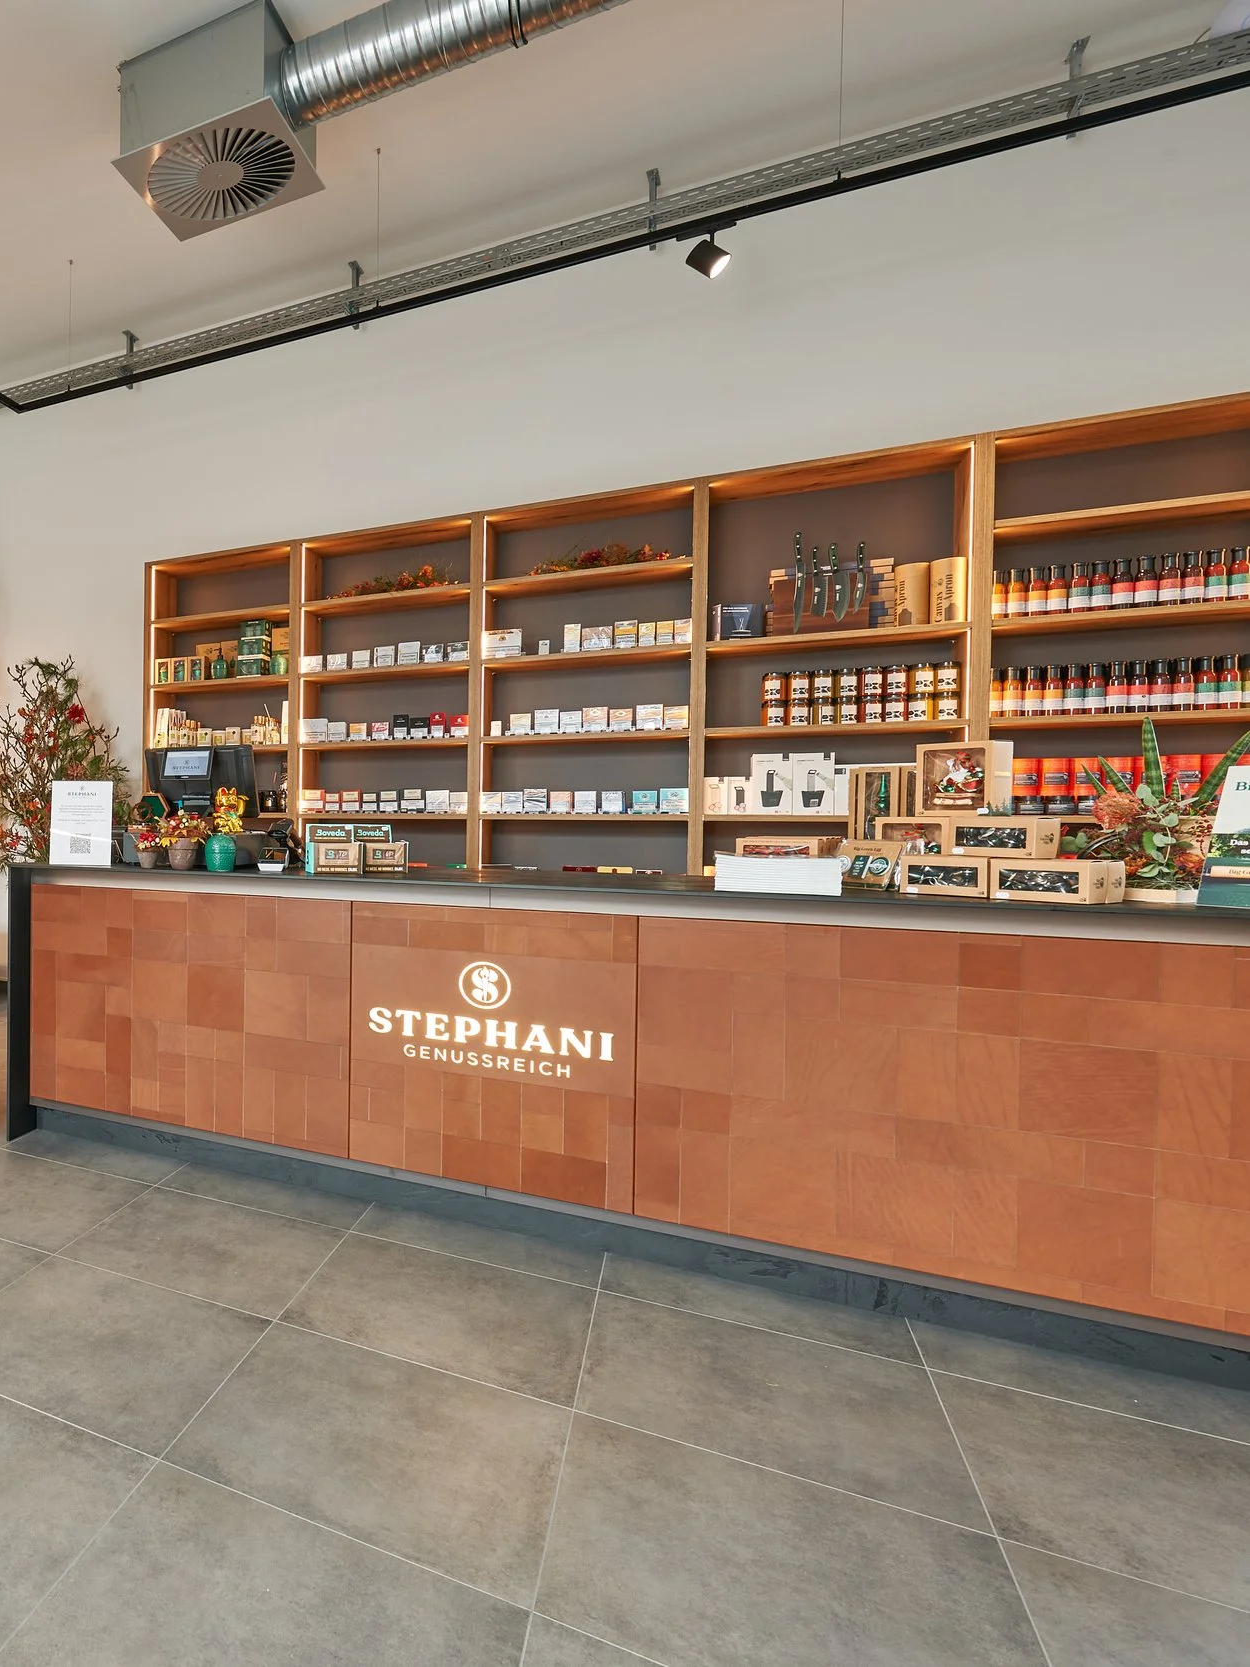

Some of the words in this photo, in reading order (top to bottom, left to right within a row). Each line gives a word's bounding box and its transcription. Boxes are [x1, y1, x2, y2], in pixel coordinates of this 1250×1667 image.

[897, 580, 907, 606] Apron
[944, 573, 955, 600] Apron
[934, 591, 943, 623] Canvas
[1230, 838, 1249, 846] Das
[368, 1006, 614, 1062] STEPHANI
[403, 1043, 571, 1079] GENUSSREICH
